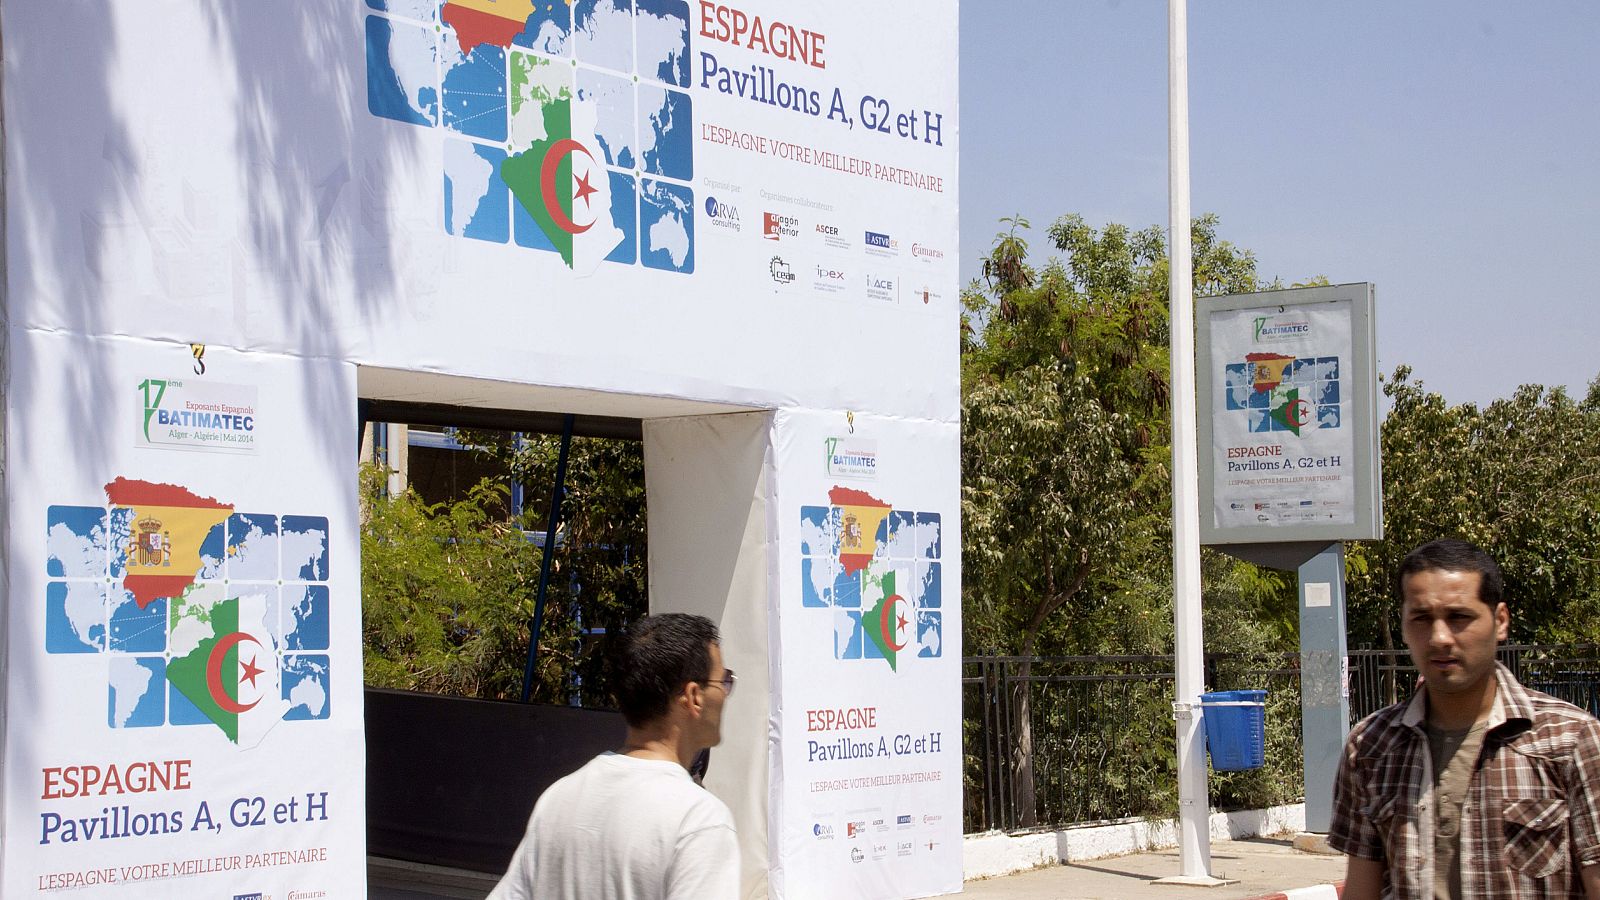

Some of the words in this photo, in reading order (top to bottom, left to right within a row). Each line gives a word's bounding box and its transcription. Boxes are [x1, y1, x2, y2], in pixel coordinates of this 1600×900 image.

[699, 0, 825, 69] ESPAGNE
[700, 51, 821, 116] Pavillons
[827, 88, 853, 130] A,
[859, 95, 891, 134] G2
[896, 109, 918, 139] et
[923, 110, 943, 146] H
[702, 123, 767, 154] L'ESPAGNE
[769, 139, 811, 164] VOTRE
[813, 150, 872, 178] MEILLEUR
[875, 164, 943, 193] PARTENAIRE
[711, 201, 740, 221] ARVA
[712, 218, 741, 232] consulting
[771, 213, 799, 227] aragón
[771, 224, 799, 237] exterior
[815, 224, 839, 236] ASCER
[776, 270, 796, 281] ceam
[817, 264, 844, 280] ipex
[1262, 325, 1309, 335] BATIMATEC
[186, 401, 220, 412] Exposants
[221, 404, 254, 415] Espagnols
[158, 409, 254, 431] BATIMATEC
[168, 429, 188, 440] Alger
[193, 431, 219, 442] Algérie
[223, 433, 237, 442] Mai
[238, 434, 254, 443] 2014
[1227, 445, 1282, 458] ESPAGNE
[833, 455, 876, 468] BATIMATEC
[1228, 459, 1280, 472] Pavillons
[1283, 458, 1296, 470] A,
[1297, 457, 1314, 468] G2
[1316, 457, 1327, 467] et
[1330, 455, 1341, 466] H
[807, 707, 877, 732] ESPAGNE
[807, 738, 874, 762] Pavillons
[877, 735, 891, 759] A,
[894, 734, 912, 755] G2
[914, 734, 927, 753] et
[929, 732, 941, 752] H
[41, 759, 191, 800] ESPAGNE
[810, 779, 849, 792] L'ESPAGNE
[849, 777, 870, 789] VOTRE
[870, 774, 901, 787] MEILLEUR
[902, 770, 941, 784] PARTENAIRE
[39, 805, 183, 845] Pavillons
[190, 800, 222, 834] A,
[229, 796, 266, 827] G2
[273, 795, 298, 824] et
[305, 792, 328, 821] H
[38, 868, 117, 890] L'ESPAGNE
[121, 863, 170, 881] VOTRE
[172, 856, 242, 876] MEILLEUR
[245, 847, 327, 869] PARTENAIRE
